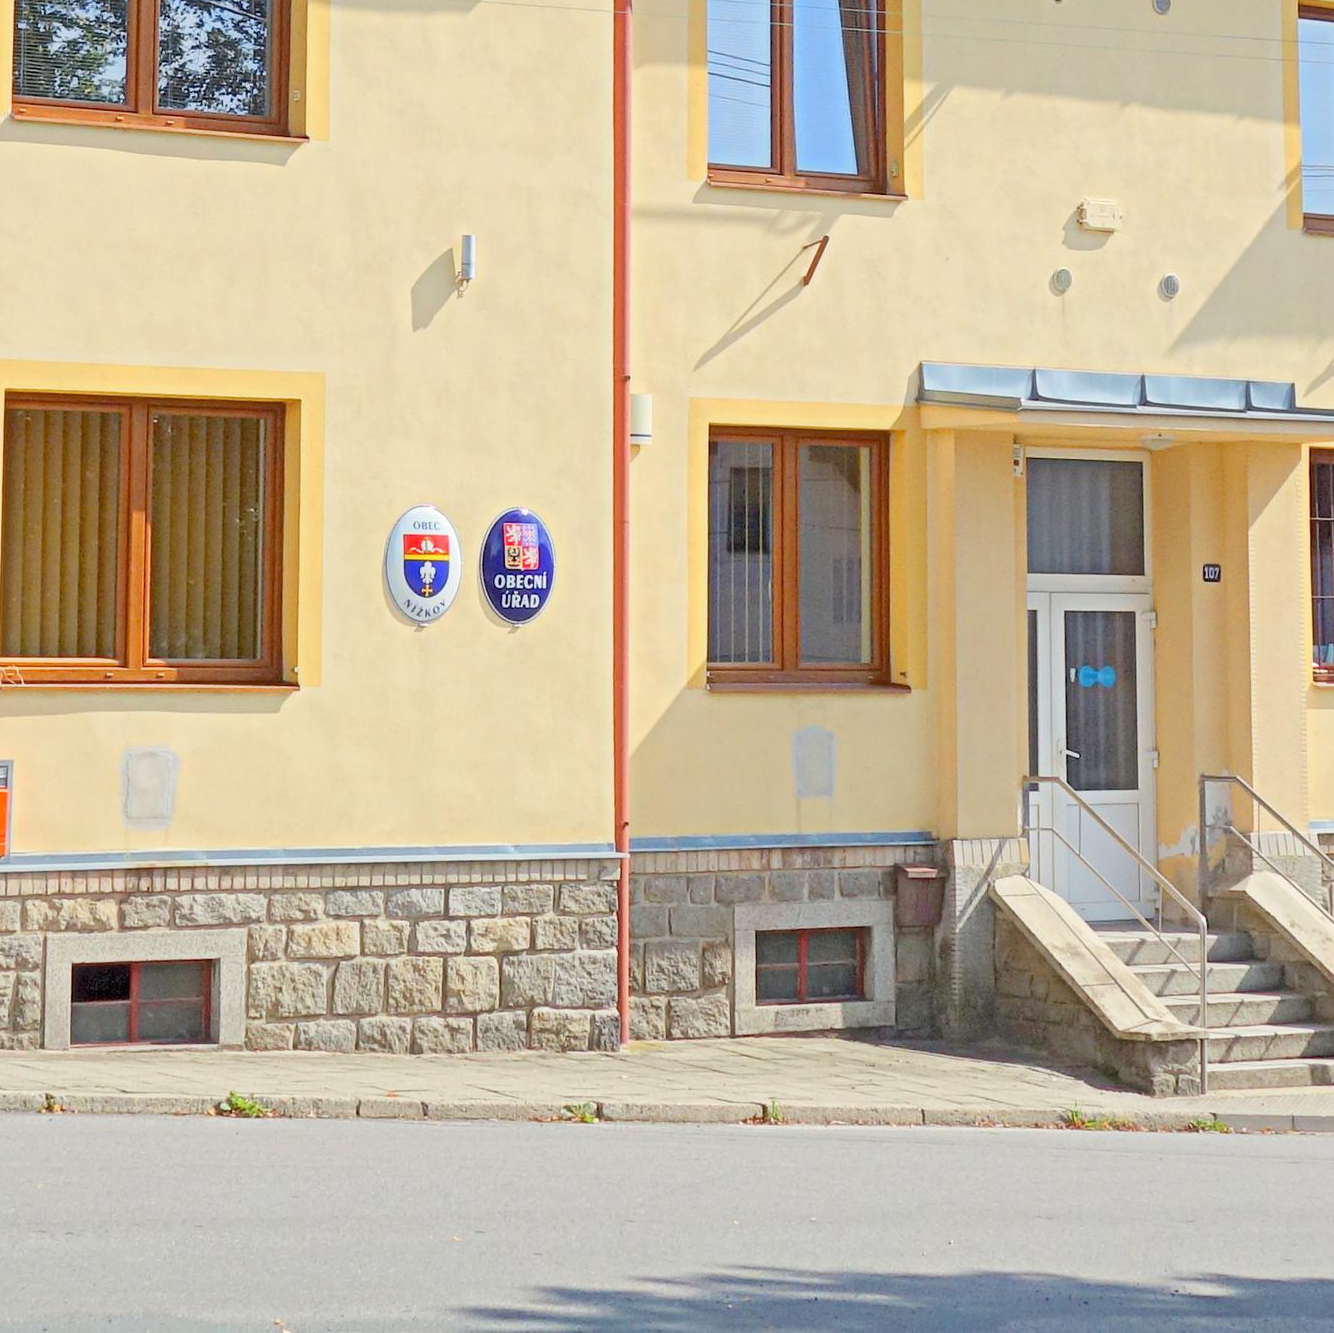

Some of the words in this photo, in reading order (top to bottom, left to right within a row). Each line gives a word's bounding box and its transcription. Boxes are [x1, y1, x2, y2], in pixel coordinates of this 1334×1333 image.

[413, 521, 441, 531] OBEC
[494, 571, 547, 590] OBECNÍ
[1204, 566, 1220, 579] 107
[501, 590, 540, 609] ÚŘAD
